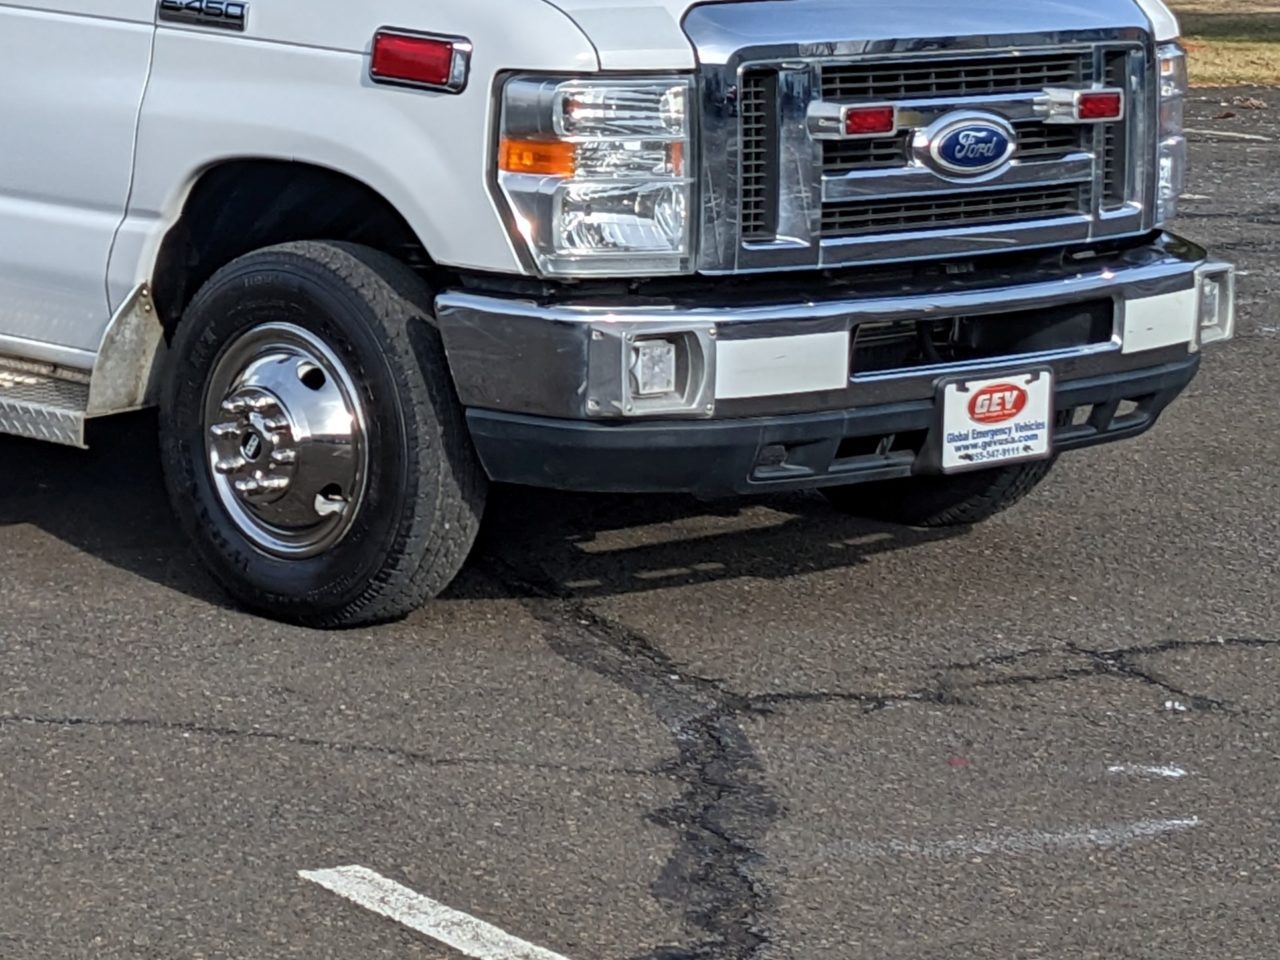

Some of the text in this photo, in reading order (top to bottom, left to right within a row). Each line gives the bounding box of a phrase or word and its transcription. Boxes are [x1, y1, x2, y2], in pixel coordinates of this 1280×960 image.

[955, 130, 997, 159] Ford
[974, 390, 1019, 414] GEV
[946, 420, 1045, 444] Global Emergency Vehicles
[954, 433, 1039, 452] www.gevusa.com
